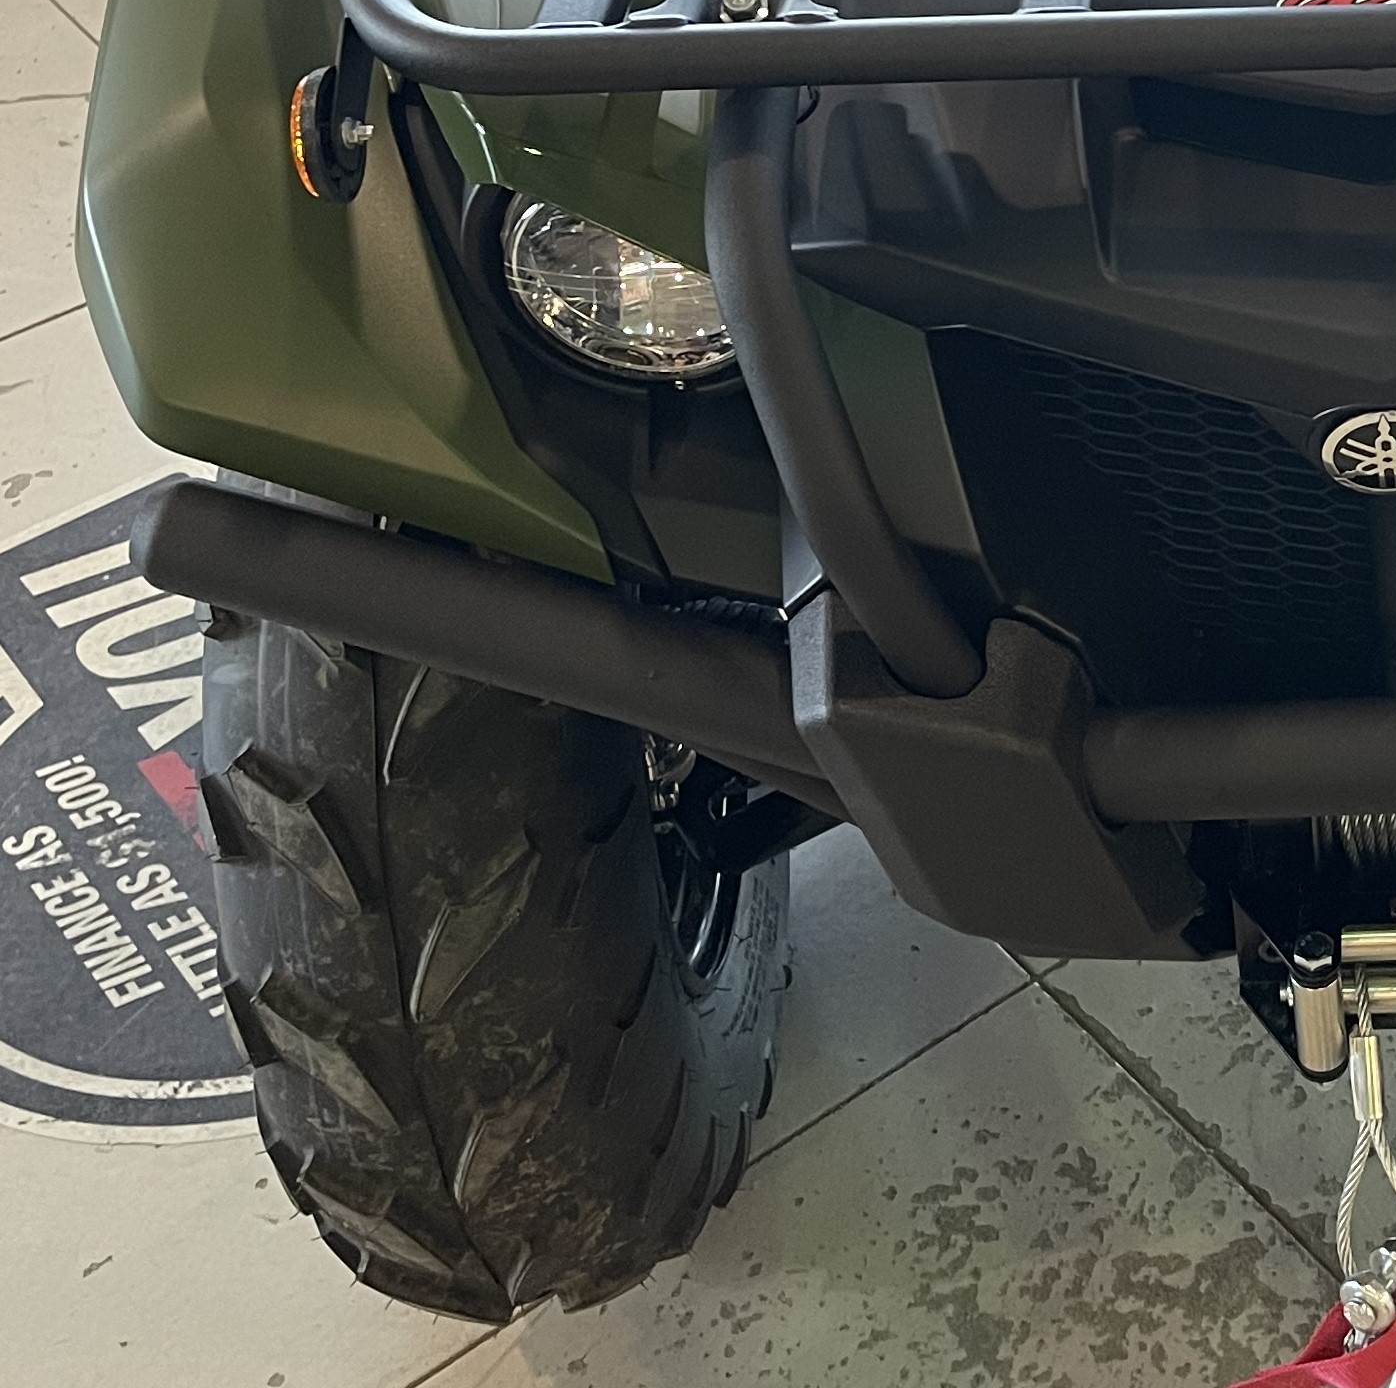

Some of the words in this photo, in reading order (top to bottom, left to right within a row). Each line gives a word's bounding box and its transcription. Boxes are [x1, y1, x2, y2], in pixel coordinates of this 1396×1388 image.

[2, 825, 73, 871] AS
[116, 863, 189, 911] AS
[31, 867, 166, 1008] FINANCE
